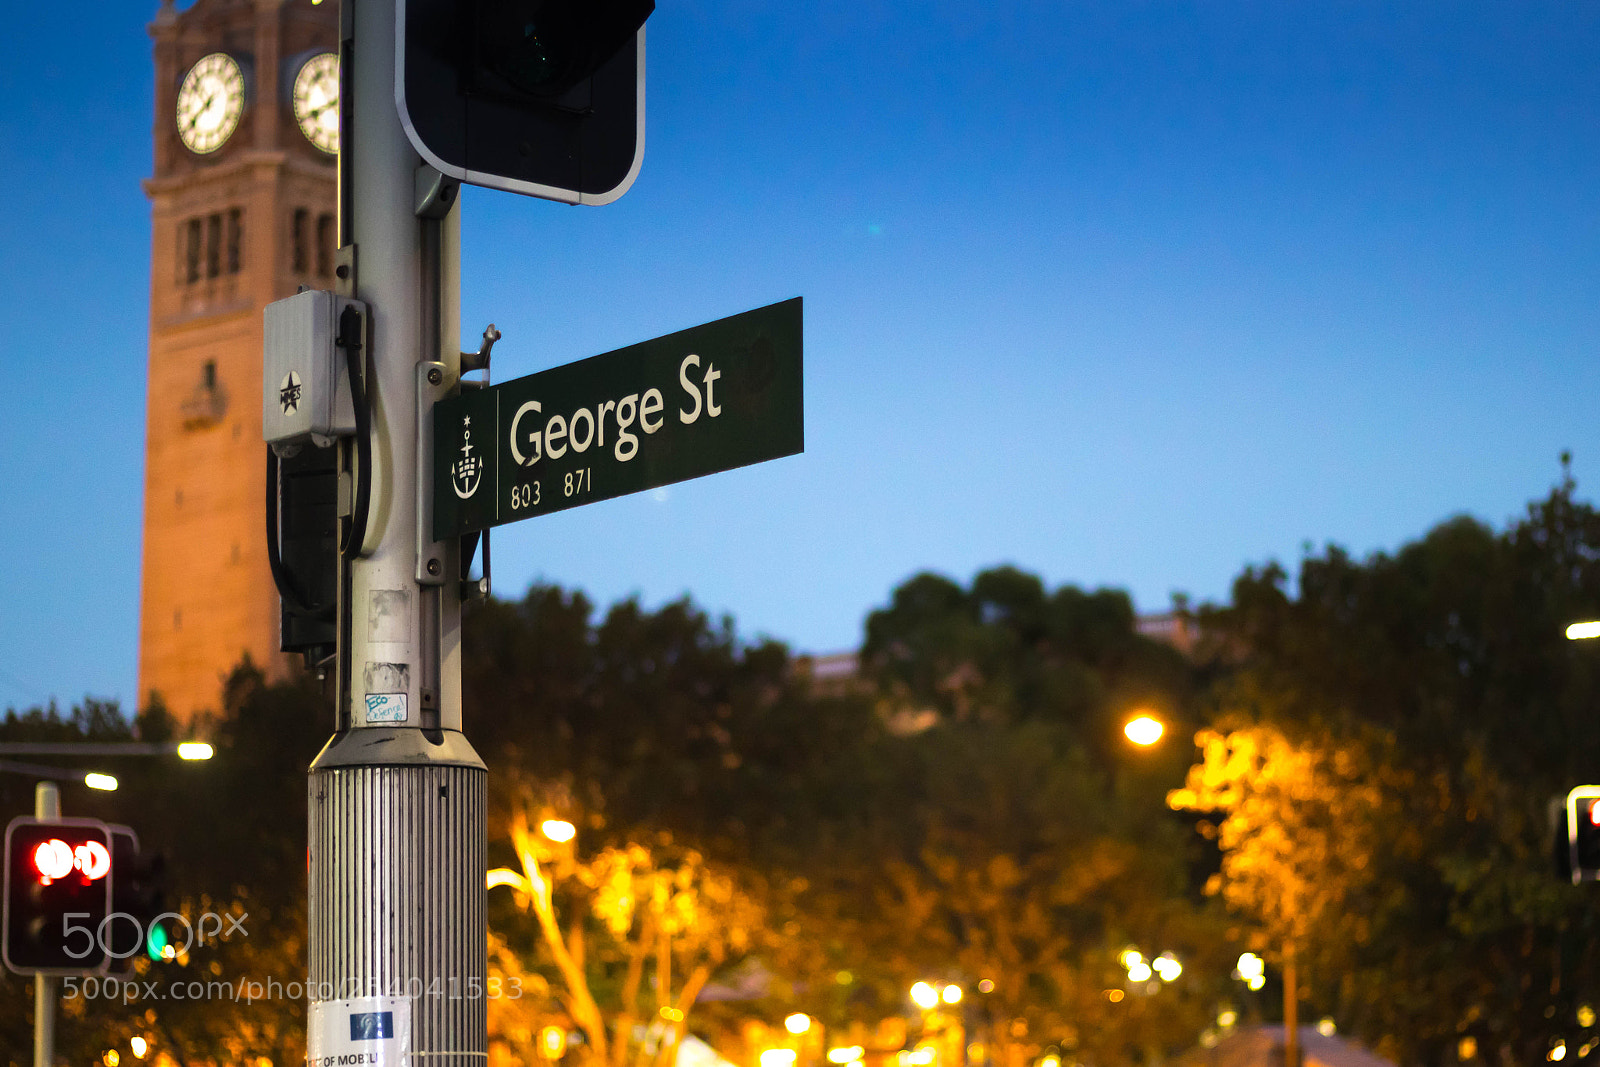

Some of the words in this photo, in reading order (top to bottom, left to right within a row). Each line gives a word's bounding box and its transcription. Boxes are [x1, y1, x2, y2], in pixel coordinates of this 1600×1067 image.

[510, 388, 664, 467] George
[679, 354, 722, 425] St
[511, 480, 541, 510] 803
[564, 467, 591, 497] 871
[323, 1056, 335, 1067] OF
